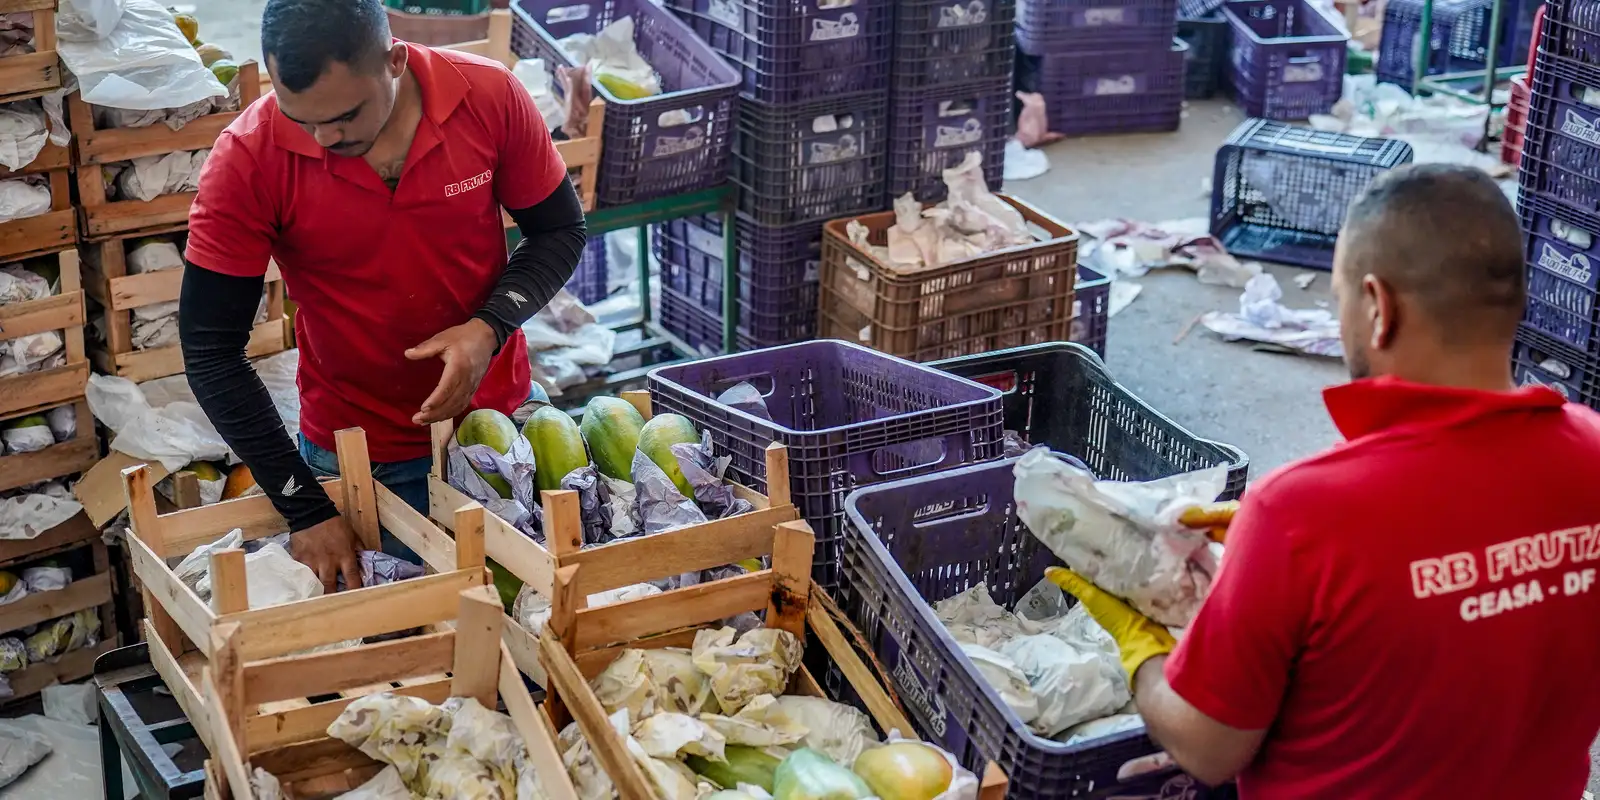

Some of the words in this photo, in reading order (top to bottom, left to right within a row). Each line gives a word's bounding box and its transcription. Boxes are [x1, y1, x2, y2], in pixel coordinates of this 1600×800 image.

[444, 183, 460, 197] RB
[460, 169, 492, 193] FRUTAS
[1410, 551, 1479, 599] RB
[1459, 579, 1544, 622] CEASA
[1563, 568, 1596, 596] DF
